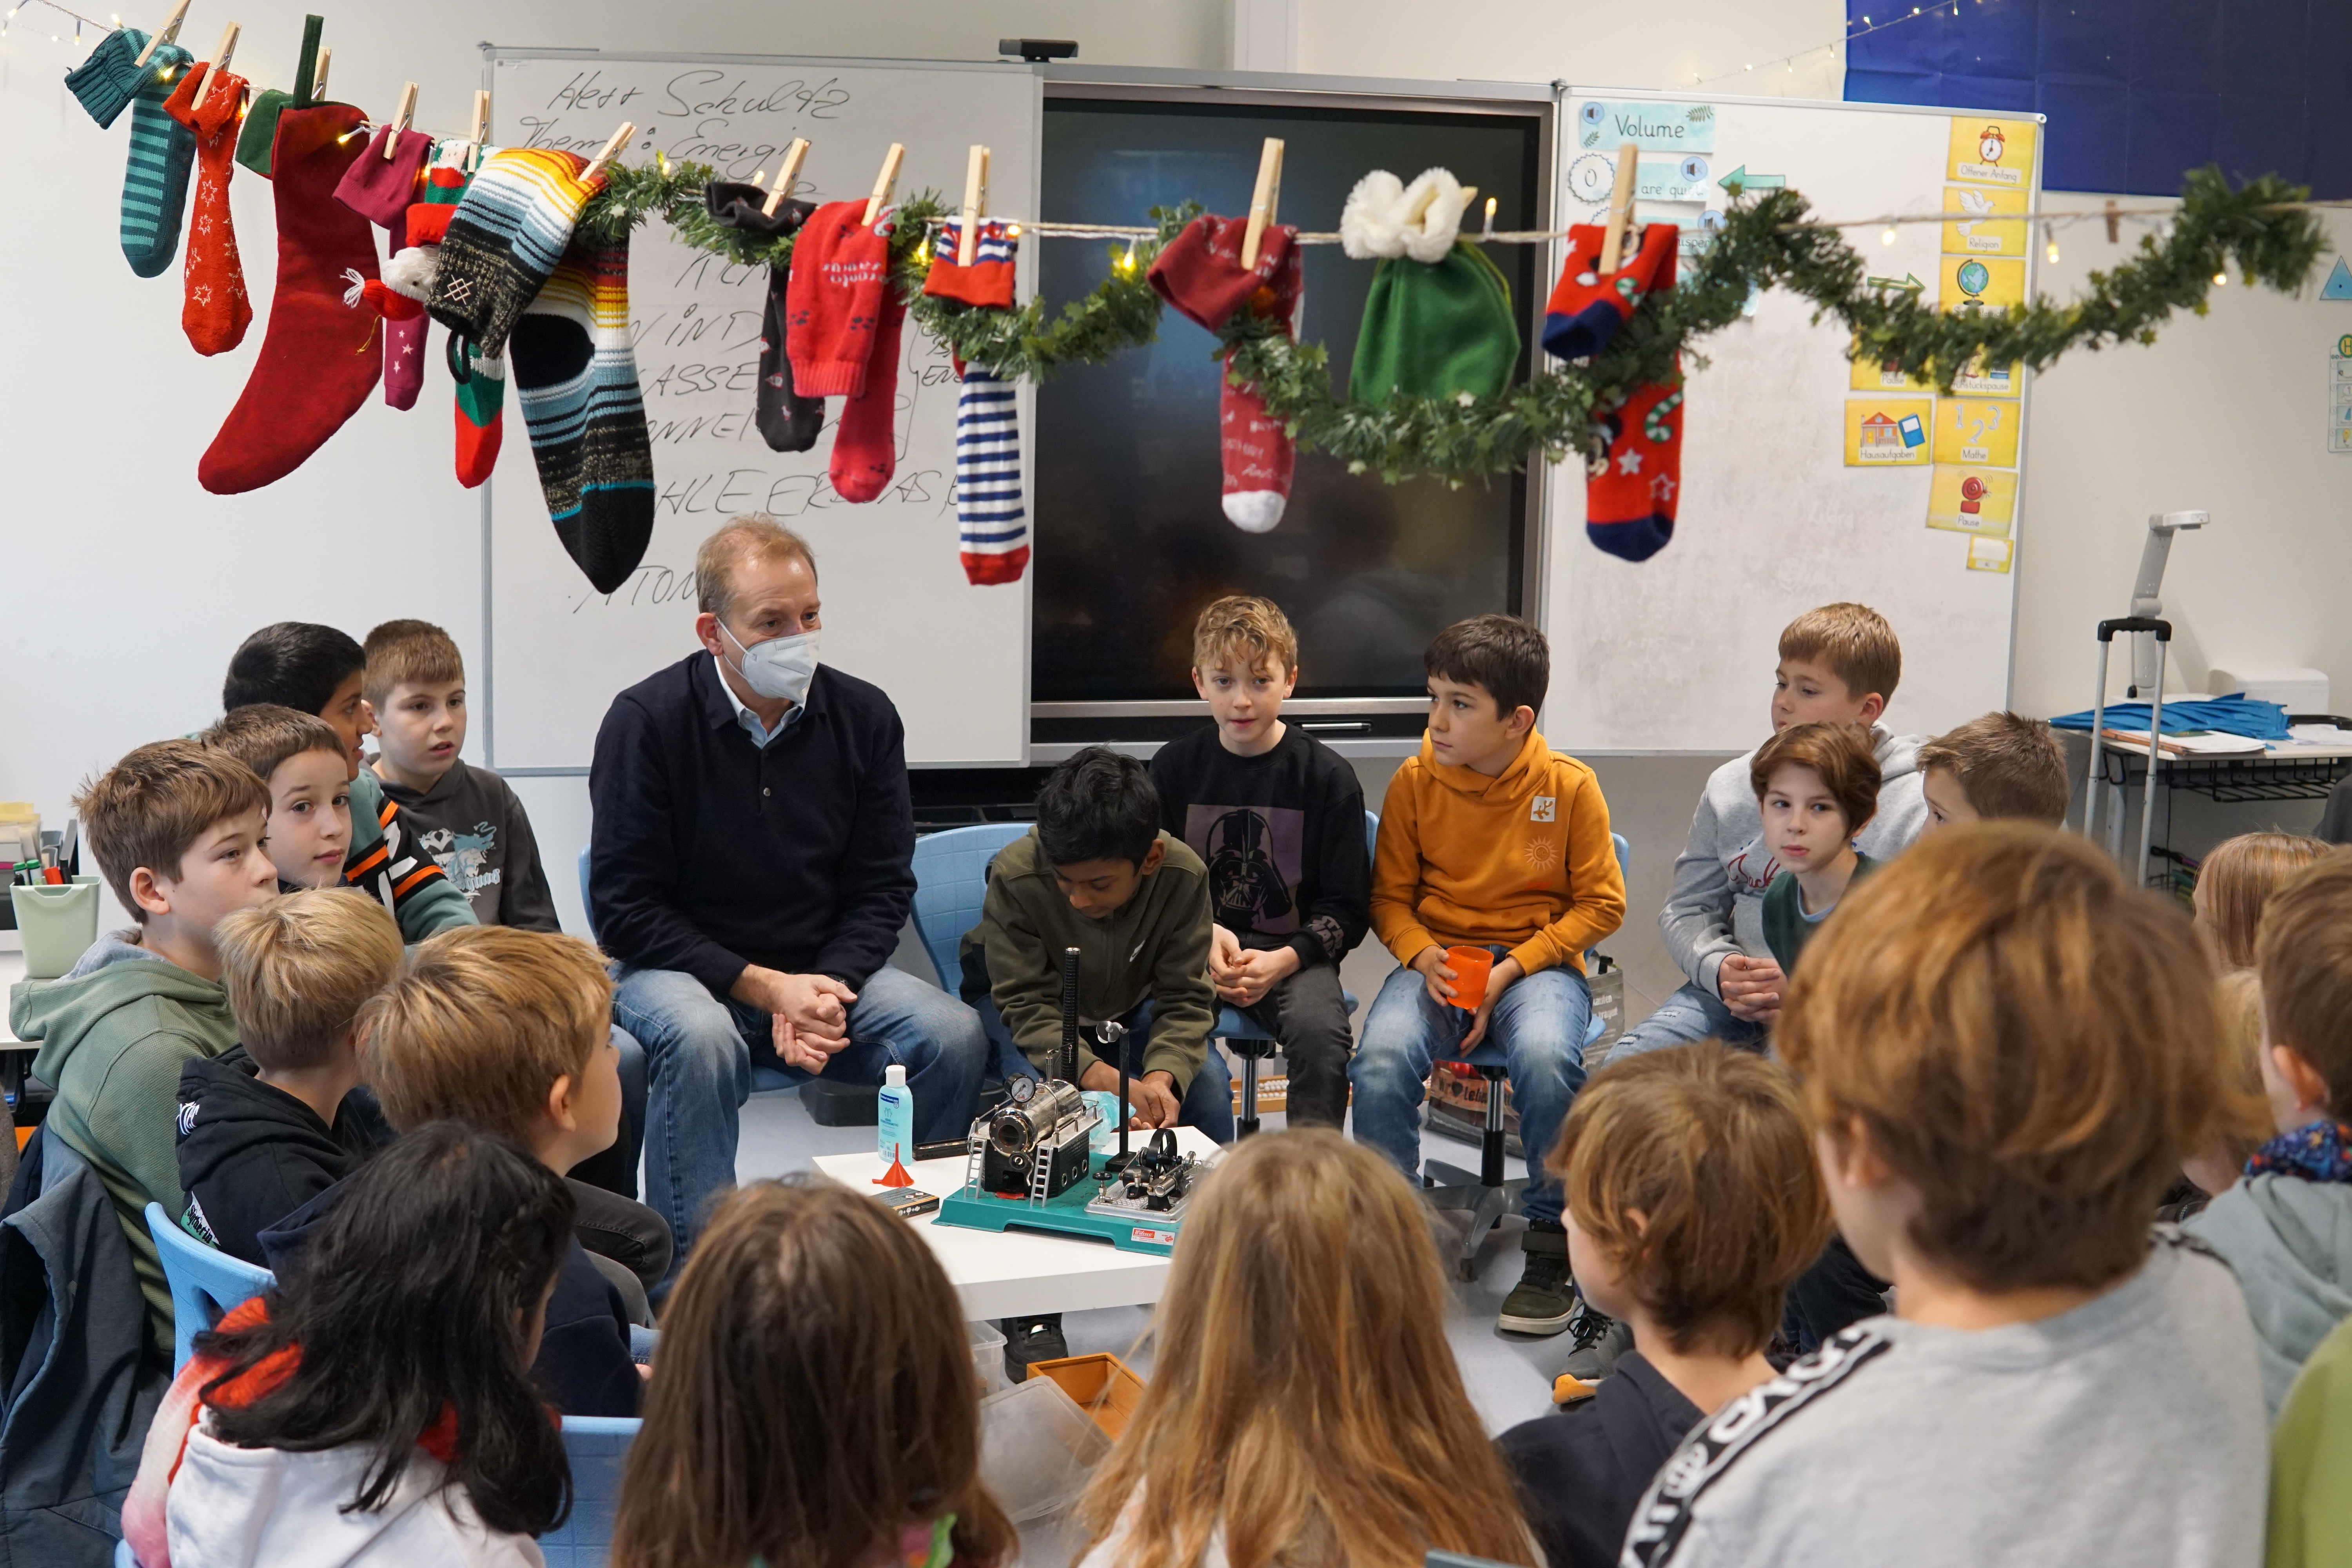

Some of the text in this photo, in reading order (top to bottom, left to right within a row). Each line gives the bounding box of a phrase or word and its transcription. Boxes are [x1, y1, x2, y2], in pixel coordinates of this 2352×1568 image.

[658, 69, 851, 119] Schultz
[1615, 114, 1685, 138] Volume
[667, 118, 811, 180] Energi
[1641, 185, 1662, 195] are
[1969, 237, 2000, 252] Religion
[1882, 374, 1905, 385] Pause
[1860, 449, 1915, 463] Hausaufgaben
[1962, 449, 1987, 460] Mathe
[1958, 514, 1980, 527] Pause
